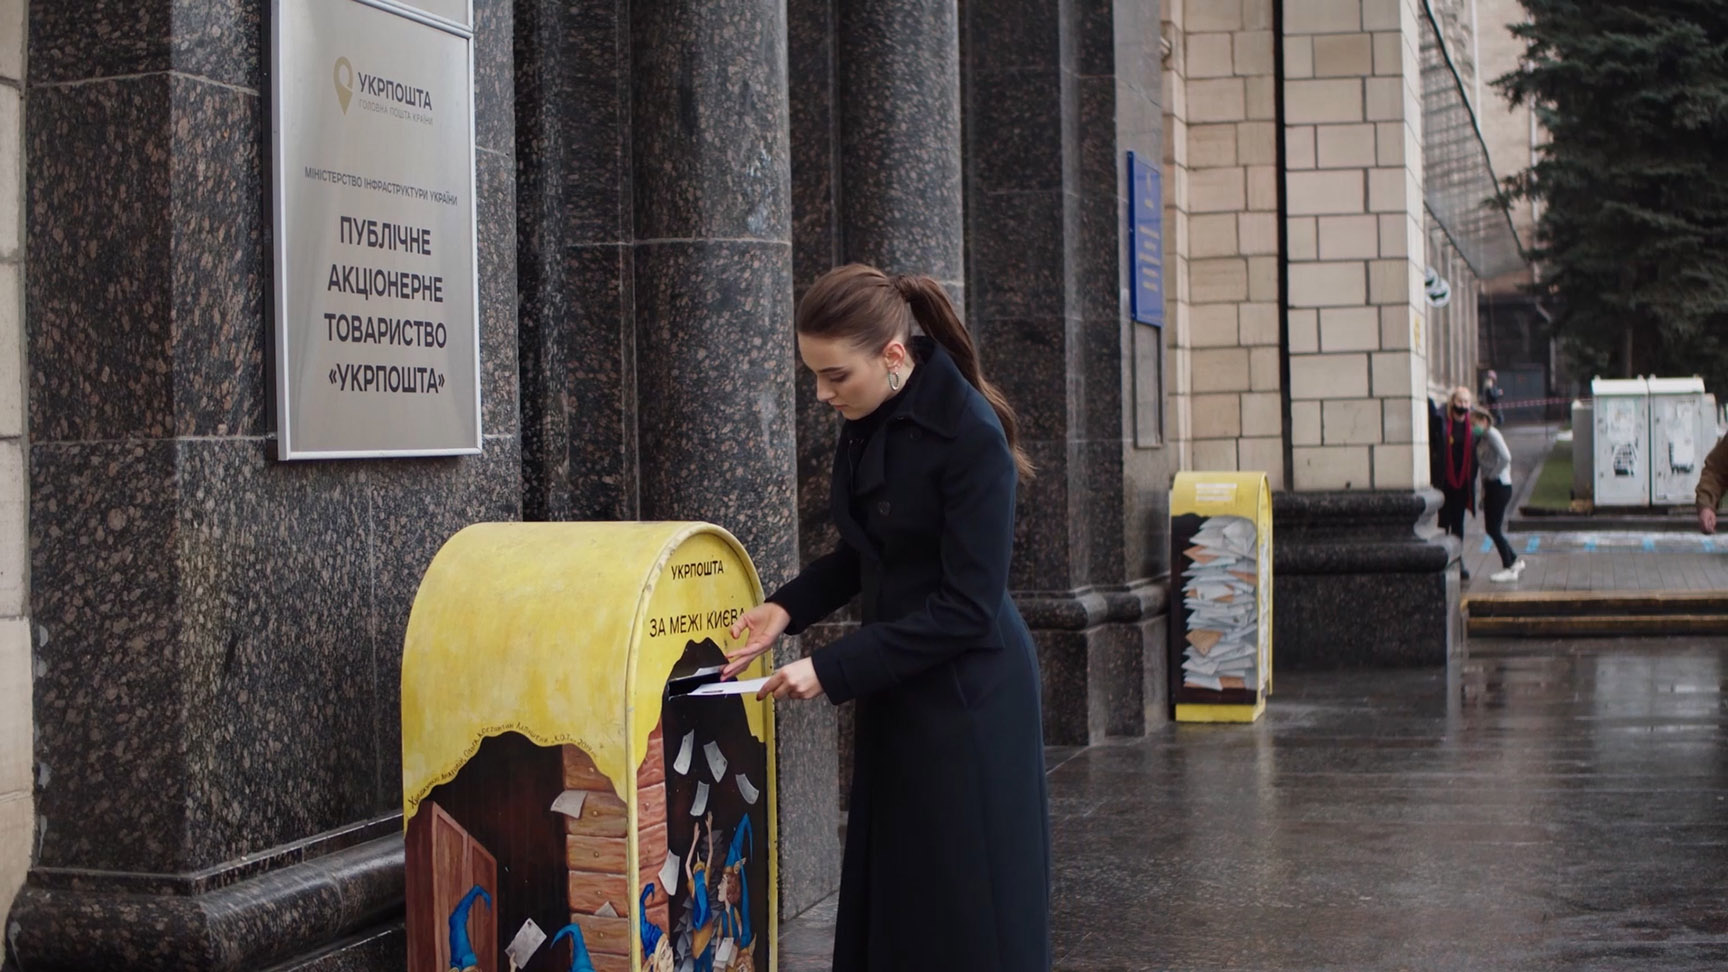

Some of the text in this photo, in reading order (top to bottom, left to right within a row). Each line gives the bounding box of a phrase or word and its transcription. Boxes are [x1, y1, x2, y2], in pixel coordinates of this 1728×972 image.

[358, 72, 432, 110] УКРПОШТА
[305, 166, 458, 206] МІНІСТЕРСТВО ІНФРАСТРУКТУРИ УКРАЇНИ
[340, 216, 431, 255] ПУБЛІЧНЕ
[327, 264, 443, 302] АКЦІОНЕРНЕ
[324, 313, 447, 348] ТОВАРИСТВО
[329, 363, 445, 394] «УКРПОШТА»
[671, 560, 724, 580] УКРПОШТА
[649, 618, 666, 637] ЗА
[669, 613, 702, 635] МЕЖІ
